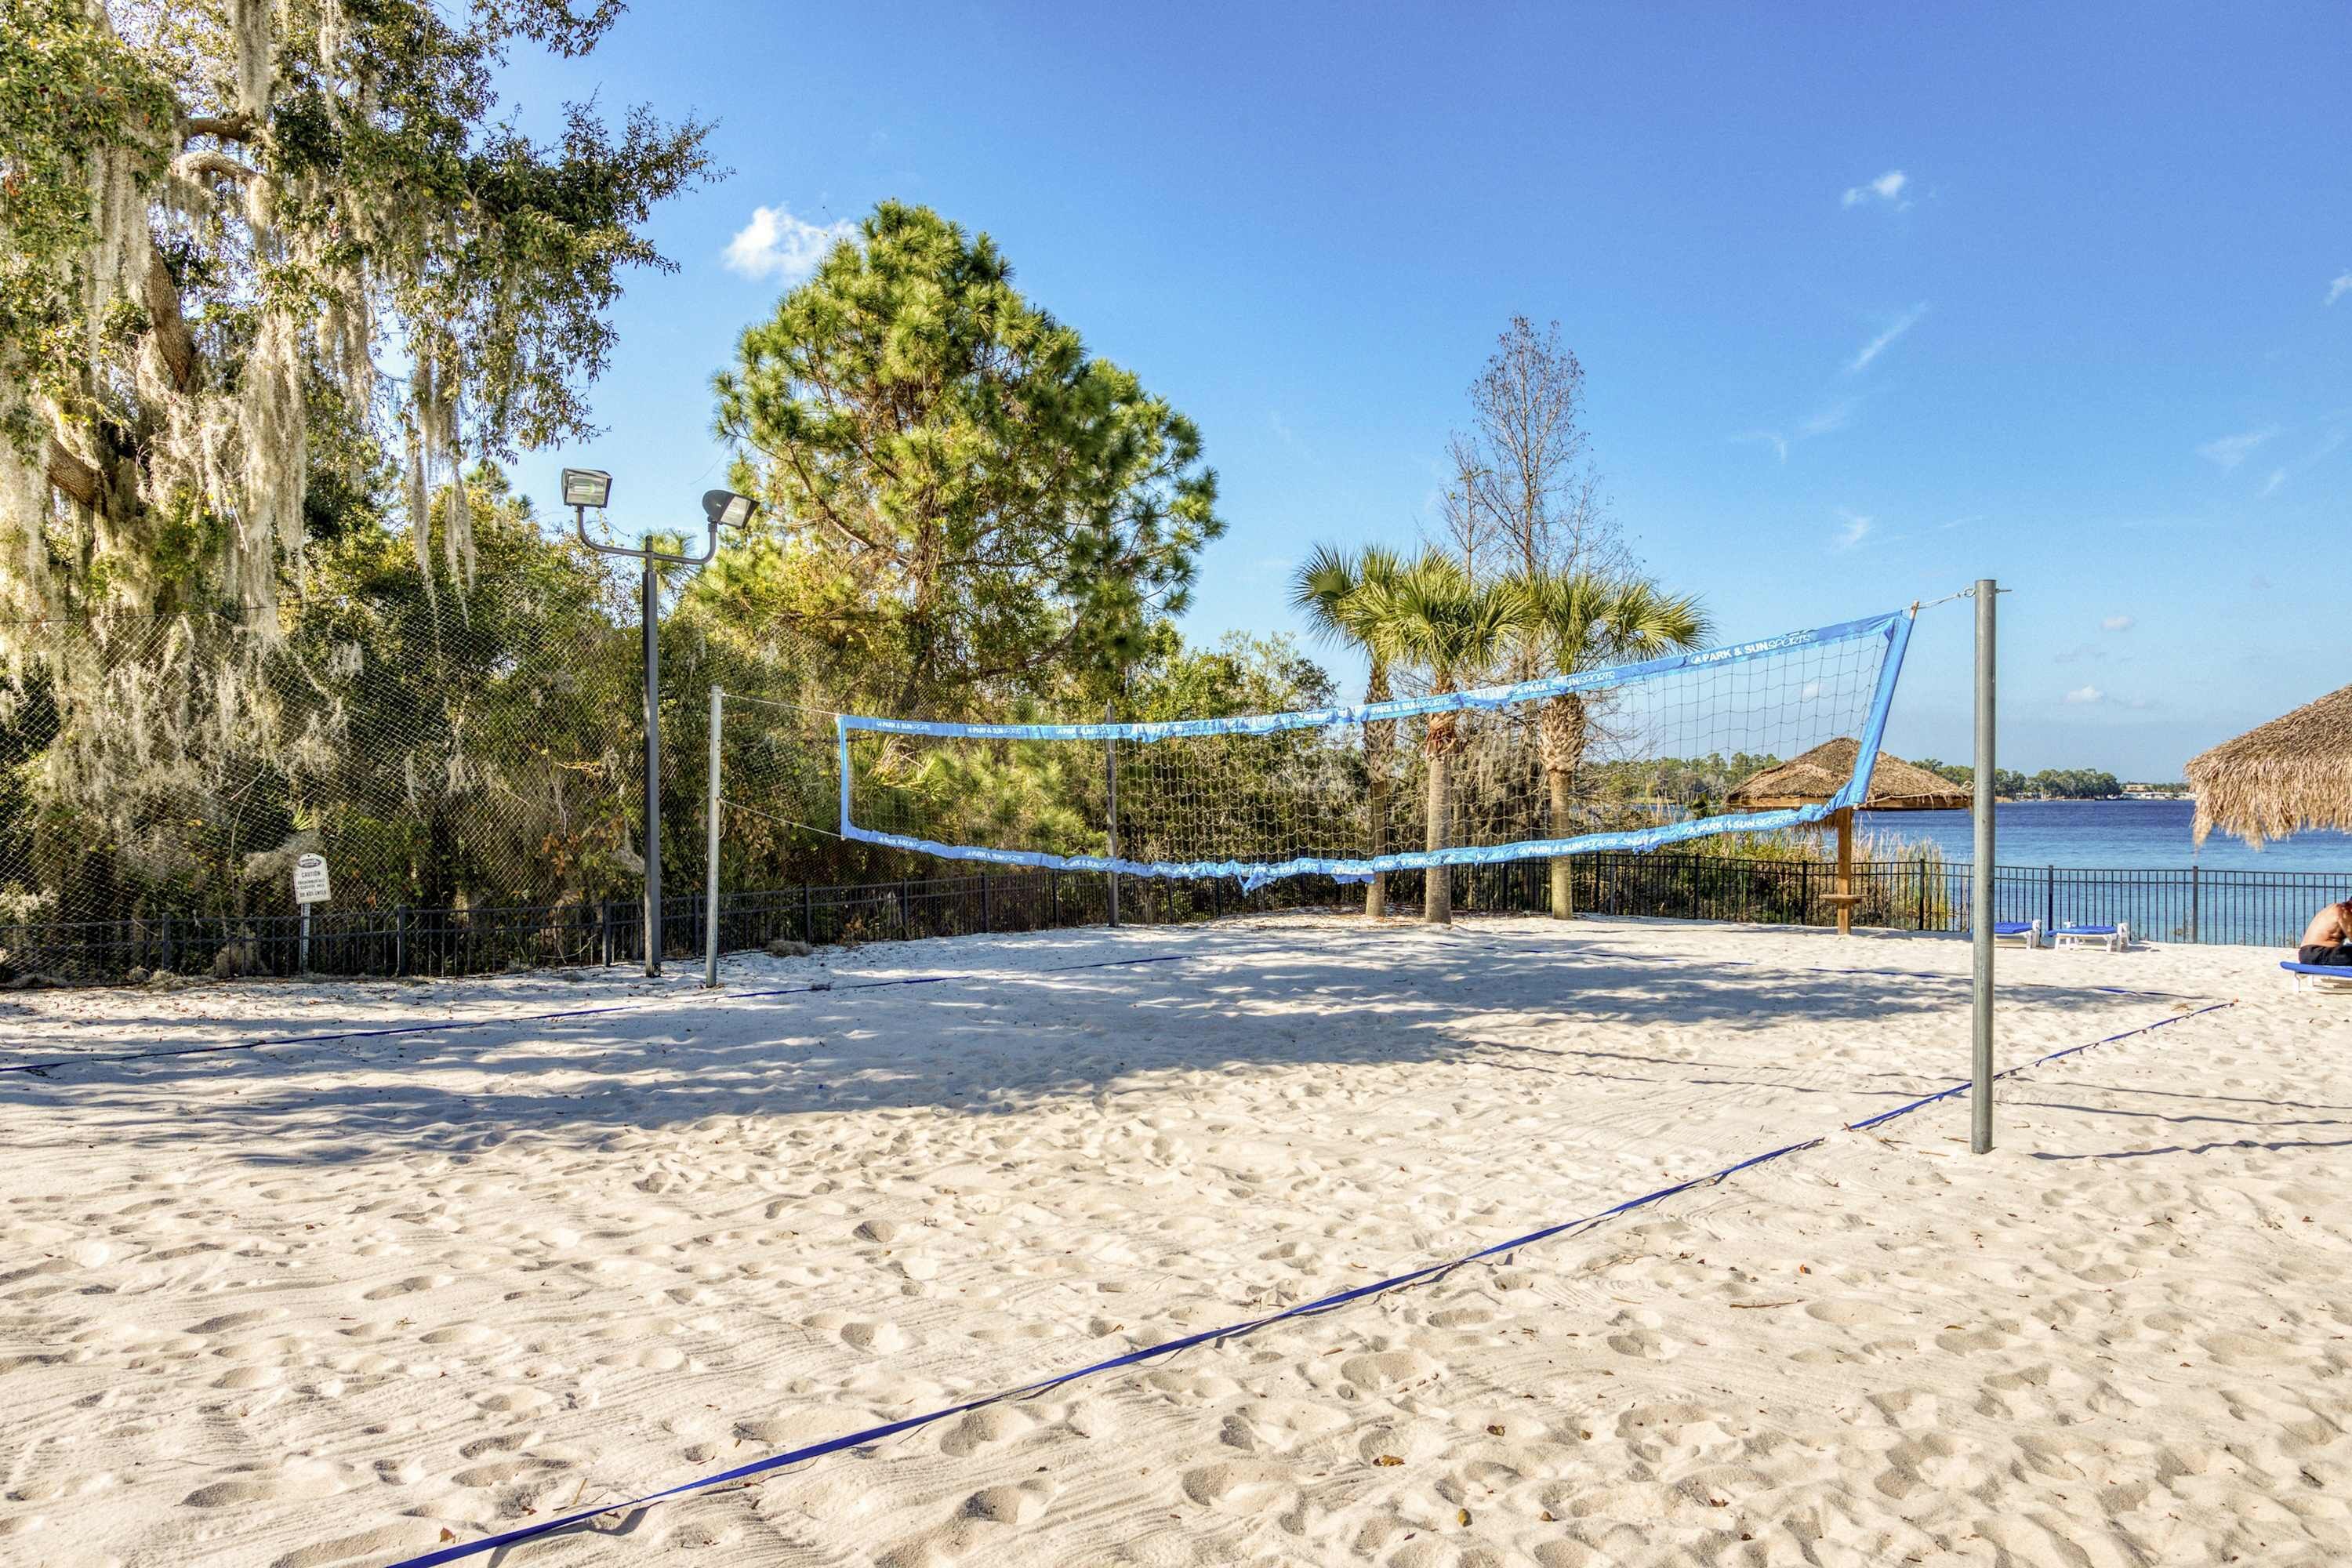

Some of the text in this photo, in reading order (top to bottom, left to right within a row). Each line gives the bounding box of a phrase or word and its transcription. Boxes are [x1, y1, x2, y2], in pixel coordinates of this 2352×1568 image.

[1702, 650, 1732, 662] PARK
[1734, 647, 1743, 656] &
[1525, 683, 1548, 694] PARK
[1372, 704, 1392, 714] PARK
[1394, 703, 1401, 712] &
[1699, 822, 1723, 835] PARK
[1529, 844, 1552, 855] PARK
